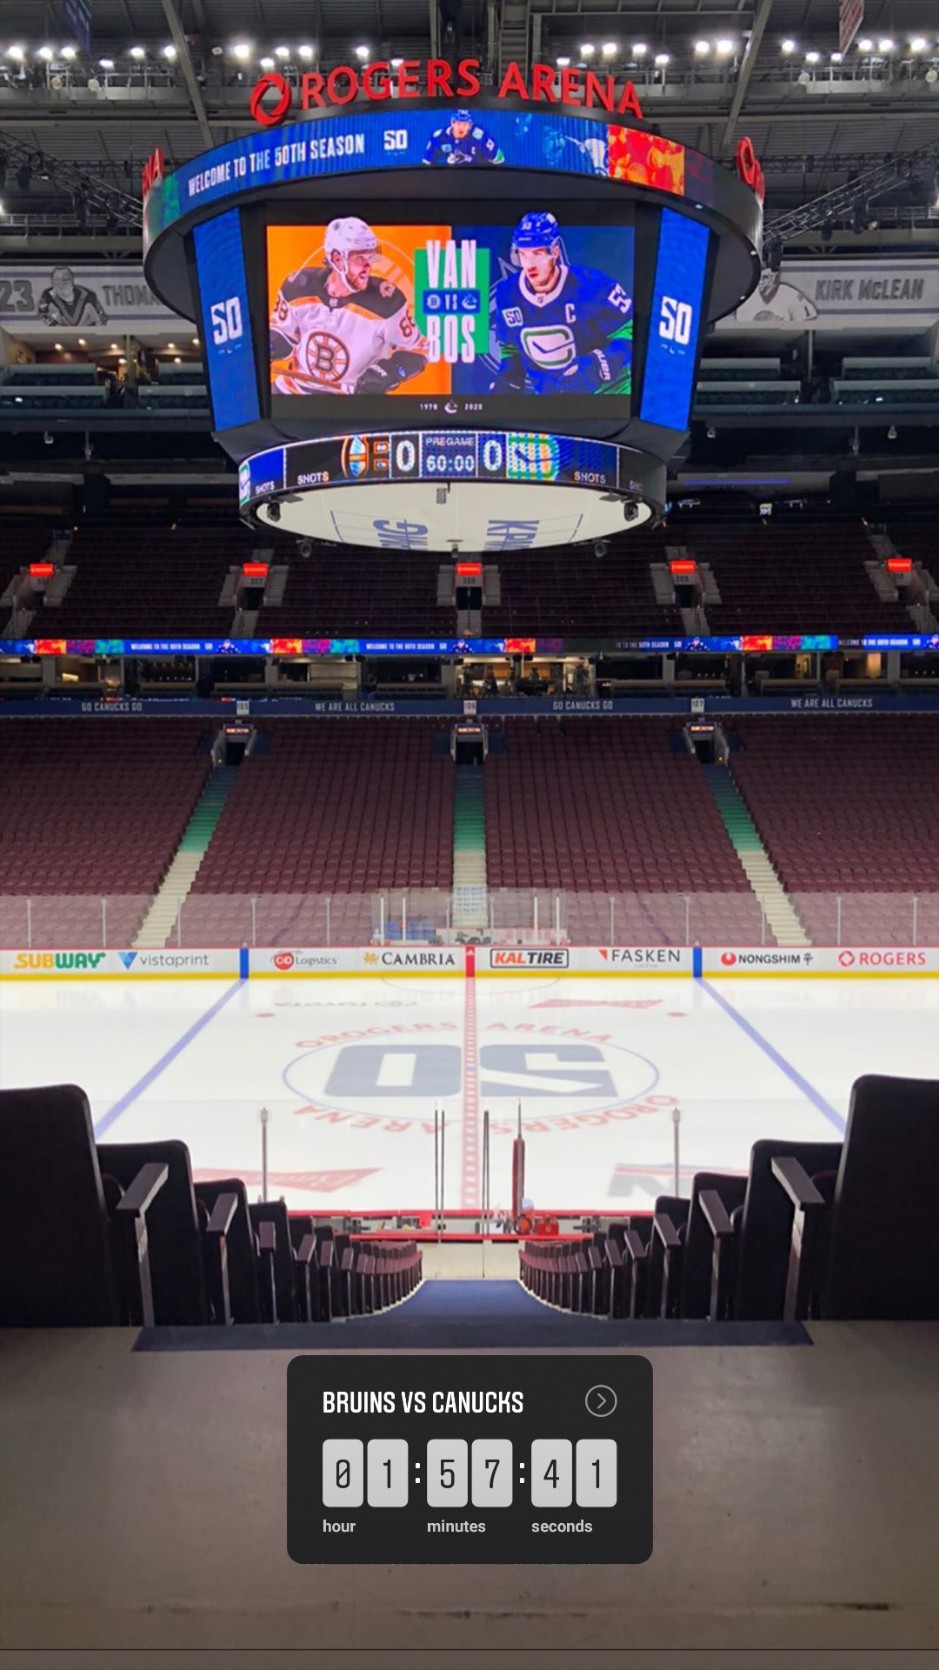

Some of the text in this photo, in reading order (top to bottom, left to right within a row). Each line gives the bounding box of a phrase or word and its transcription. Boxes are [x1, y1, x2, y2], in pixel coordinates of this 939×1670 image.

[302, 59, 644, 119] ROGERS ARENA
[383, 129, 408, 151] 50
[188, 133, 365, 197] WELCOME TO THE 50TH SEASON
[426, 239, 477, 289] VAN
[0, 280, 35, 313] 23
[815, 278, 924, 301] KIRK McLEAN
[210, 296, 243, 345] 50
[565, 303, 577, 323] C
[658, 296, 692, 345] 50
[427, 315, 476, 363] BOS
[425, 437, 475, 447] PREGAME
[396, 439, 415, 472] 0
[483, 439, 502, 471] 0
[426, 455, 475, 472] 60:00
[297, 471, 329, 485] SHOTS
[573, 471, 606, 485] SHOTS
[255, 481, 275, 494] SHOTS
[81, 703, 142, 712] GO CANUCKS GO
[315, 702, 395, 712] WE ARE ALL CANUCKS
[553, 701, 613, 710] GO CANUCKS GO
[791, 698, 873, 708] WE ARE ALL CANUCKS
[14, 952, 106, 969] SUBWAY
[140, 953, 209, 968] vistaprint
[296, 956, 338, 967] Logistics
[381, 952, 456, 966] CAMBRIA
[612, 949, 680, 962] FASKEN
[738, 953, 801, 964] NONGSHIM
[859, 952, 926, 966] ROGERS
